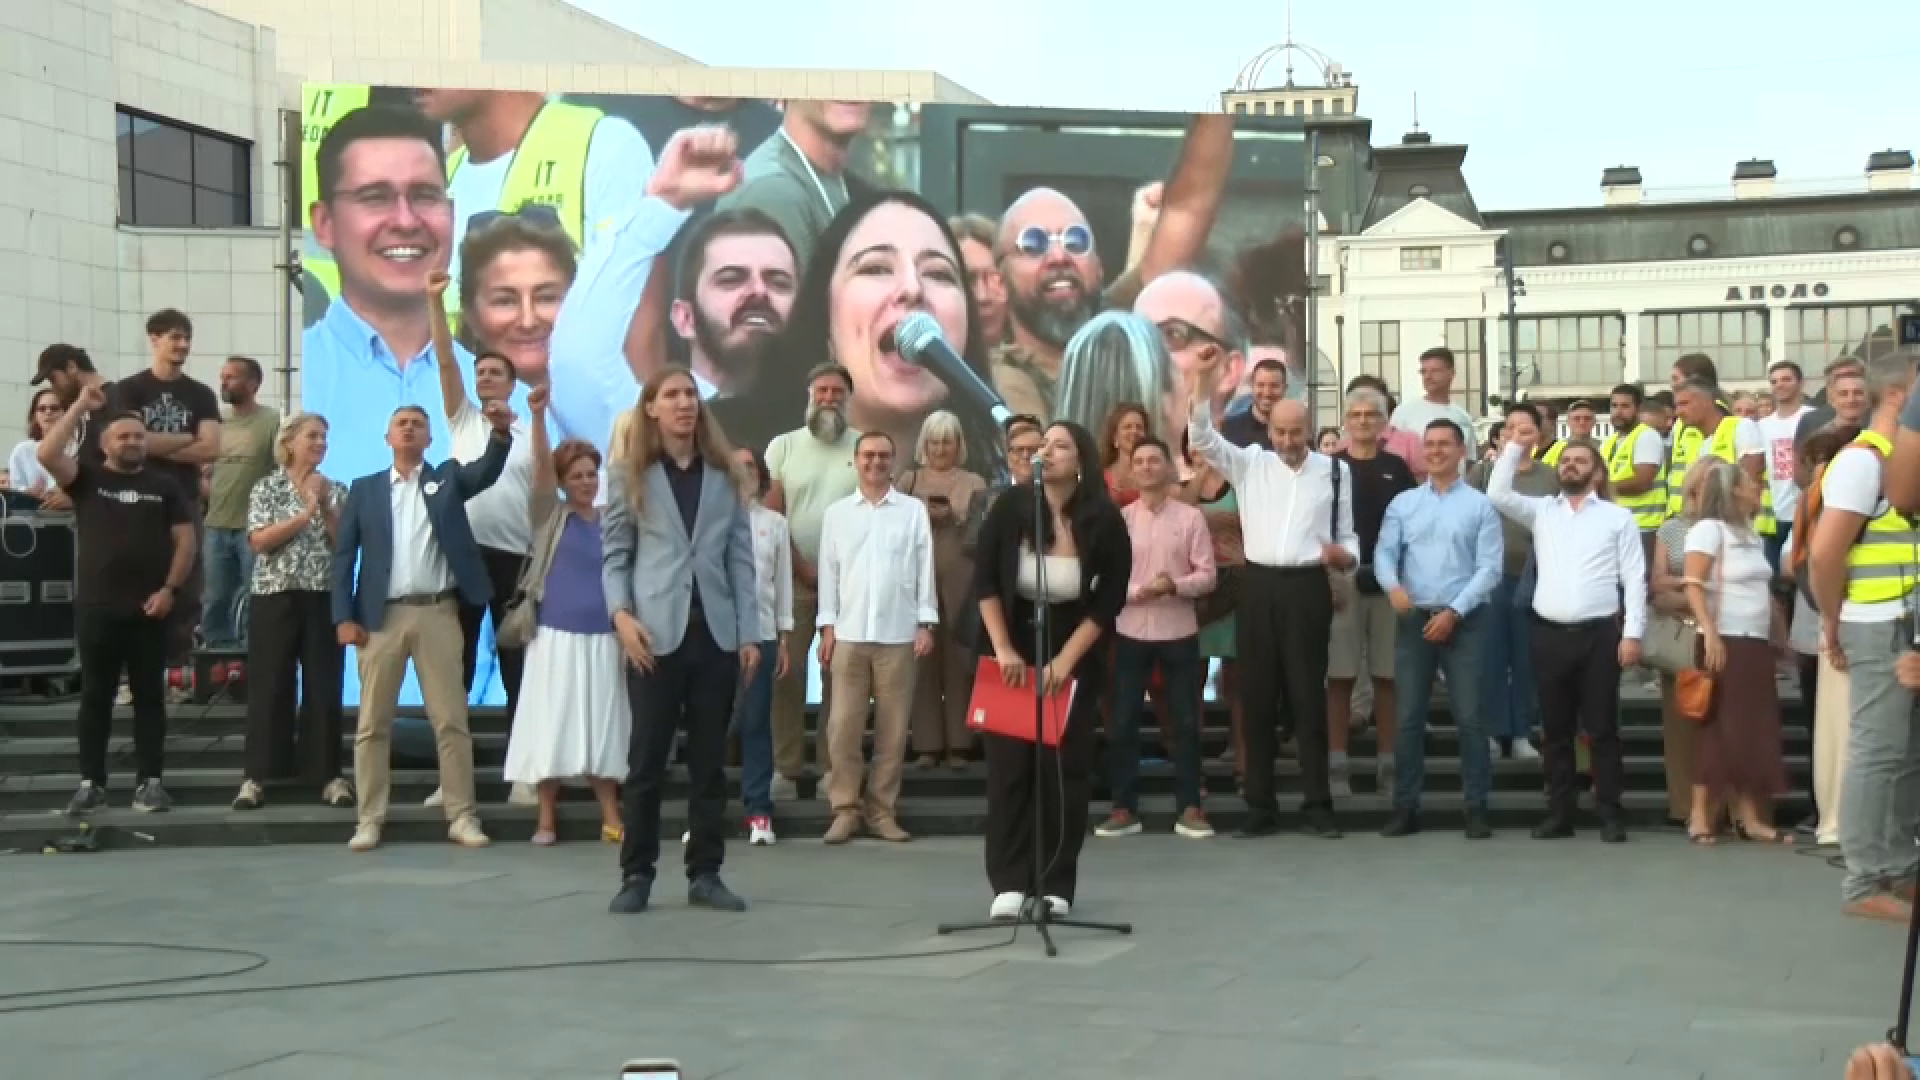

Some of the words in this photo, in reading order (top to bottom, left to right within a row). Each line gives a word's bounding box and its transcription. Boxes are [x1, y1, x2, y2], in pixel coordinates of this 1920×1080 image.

[309, 89, 334, 117] IT
[533, 160, 557, 188] IT
[1725, 282, 1829, 301] АПОЛО
